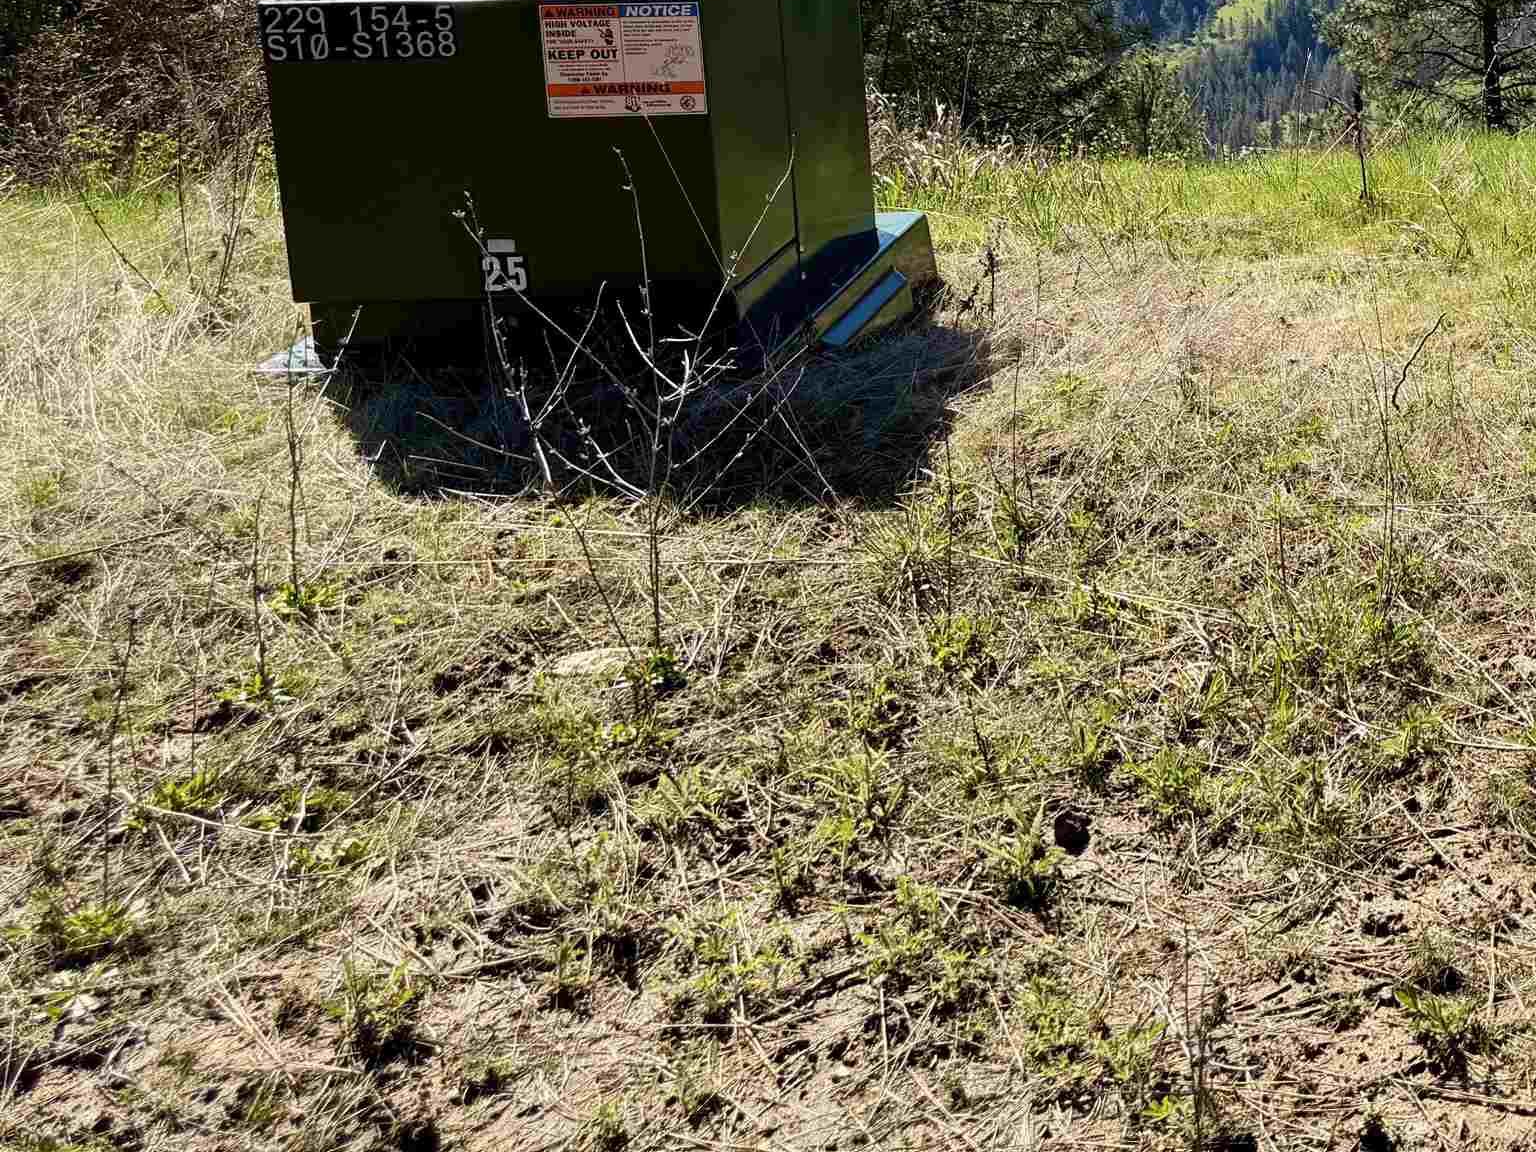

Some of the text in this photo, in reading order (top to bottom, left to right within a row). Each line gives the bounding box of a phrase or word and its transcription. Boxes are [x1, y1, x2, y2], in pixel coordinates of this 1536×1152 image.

[557, 6, 615, 17] WARNING
[625, 4, 692, 16] NOTICE
[264, 5, 453, 33] 229 154-5
[545, 19, 610, 28] HIGH VOLTAGE
[267, 31, 456, 61] S10-S1368
[548, 48, 617, 59] KEEP OUT
[592, 82, 672, 95] WARNING
[482, 256, 527, 291] 25
